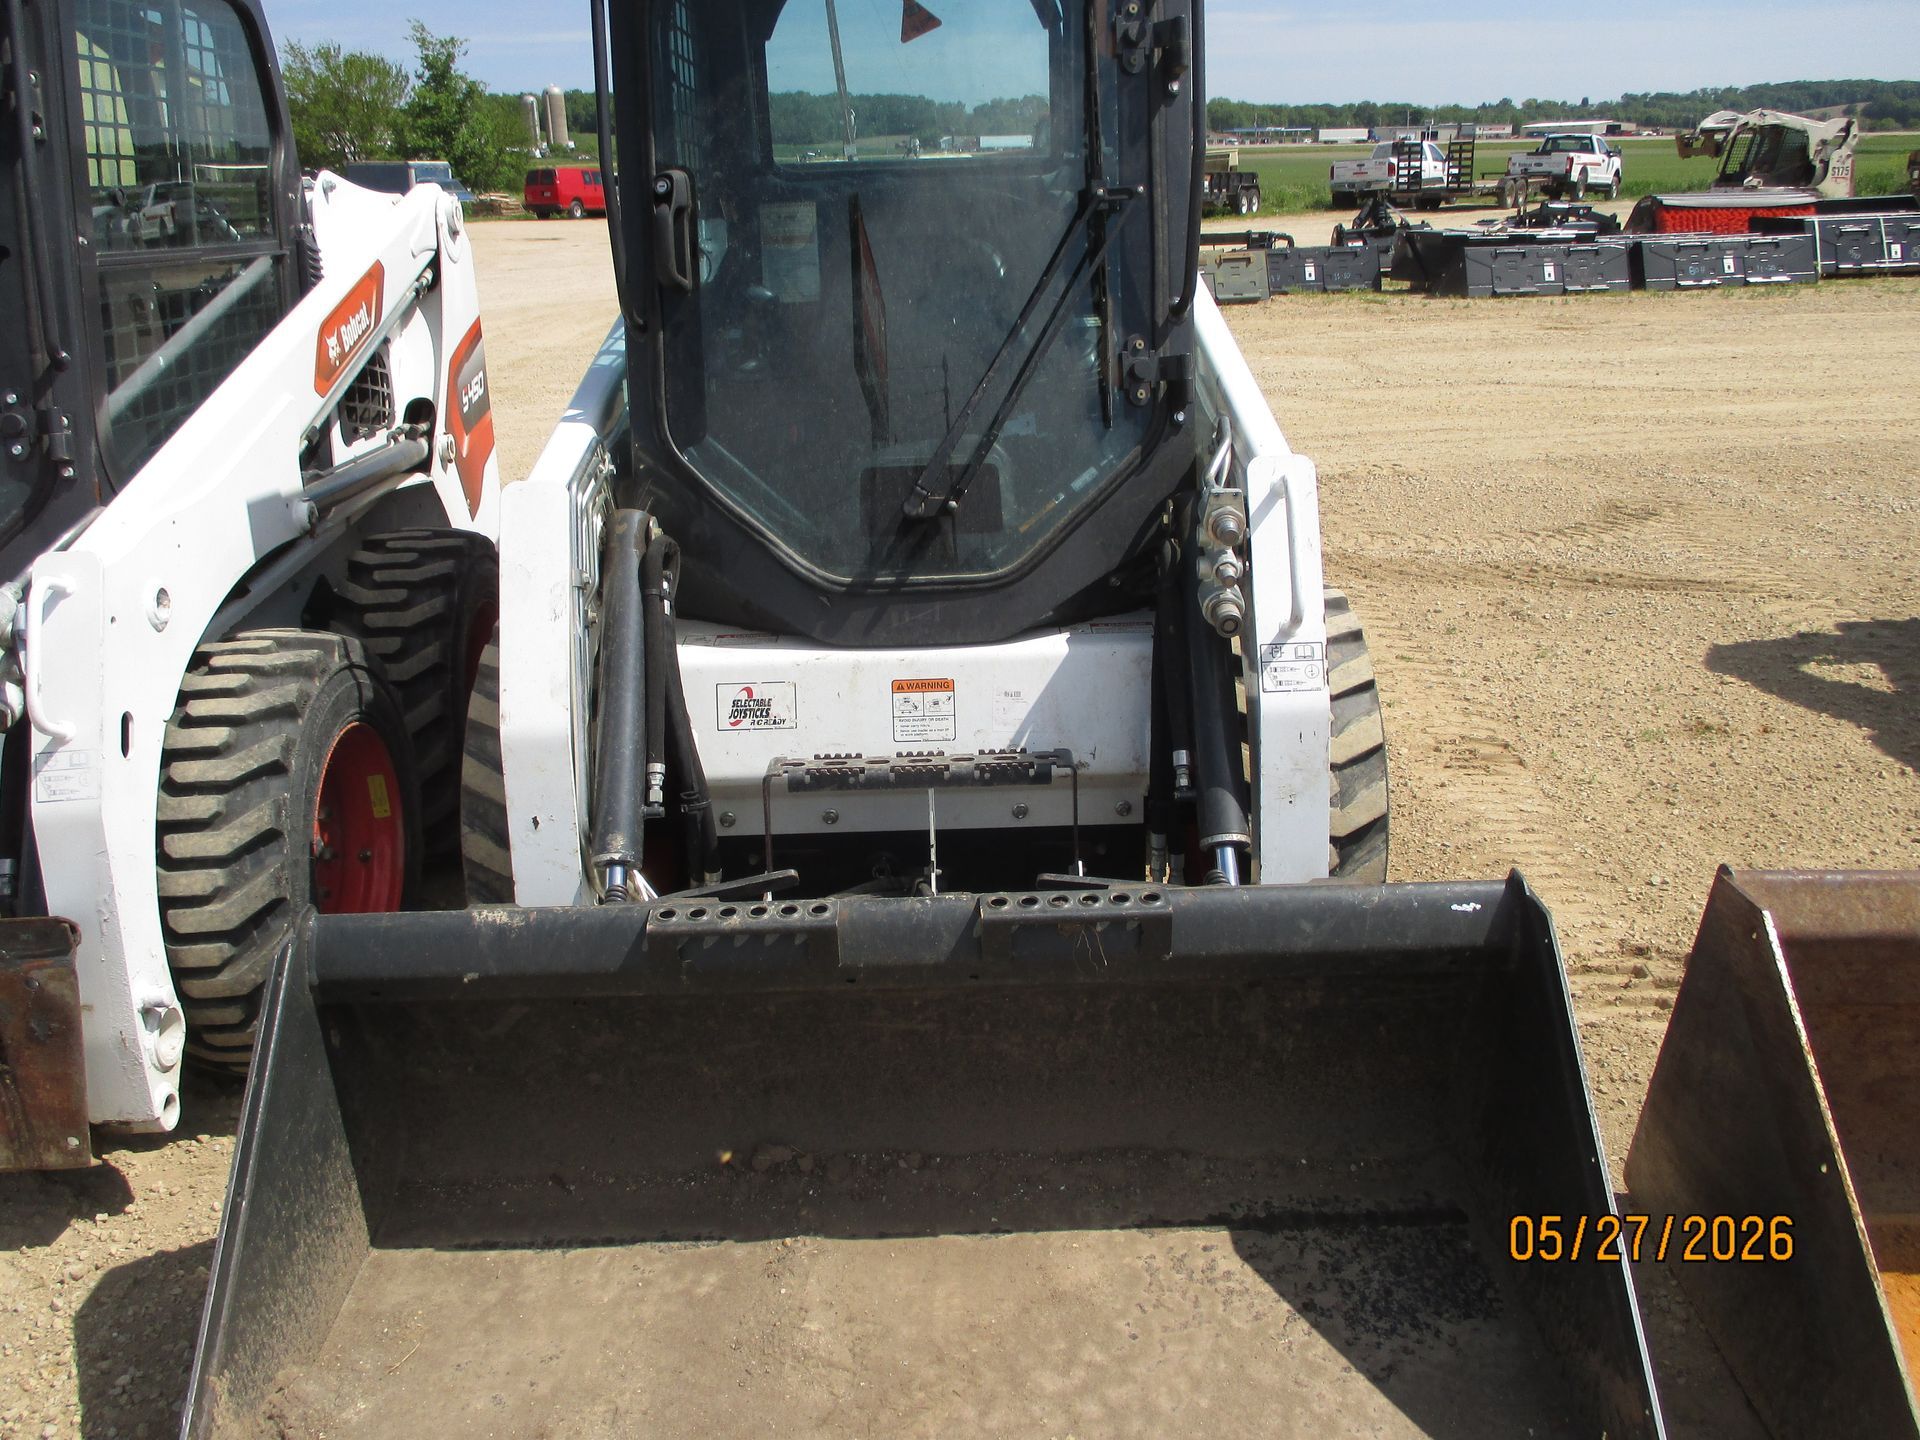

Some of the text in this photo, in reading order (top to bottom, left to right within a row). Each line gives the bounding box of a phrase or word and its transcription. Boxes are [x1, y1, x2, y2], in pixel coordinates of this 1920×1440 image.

[1831, 166, 1850, 177] S175
[339, 301, 371, 353] Bobcat
[461, 370, 485, 414] S450
[906, 681, 950, 690] WARNING
[731, 698, 773, 708] SELECTABLE
[728, 708, 771, 720] JOYSTICKS
